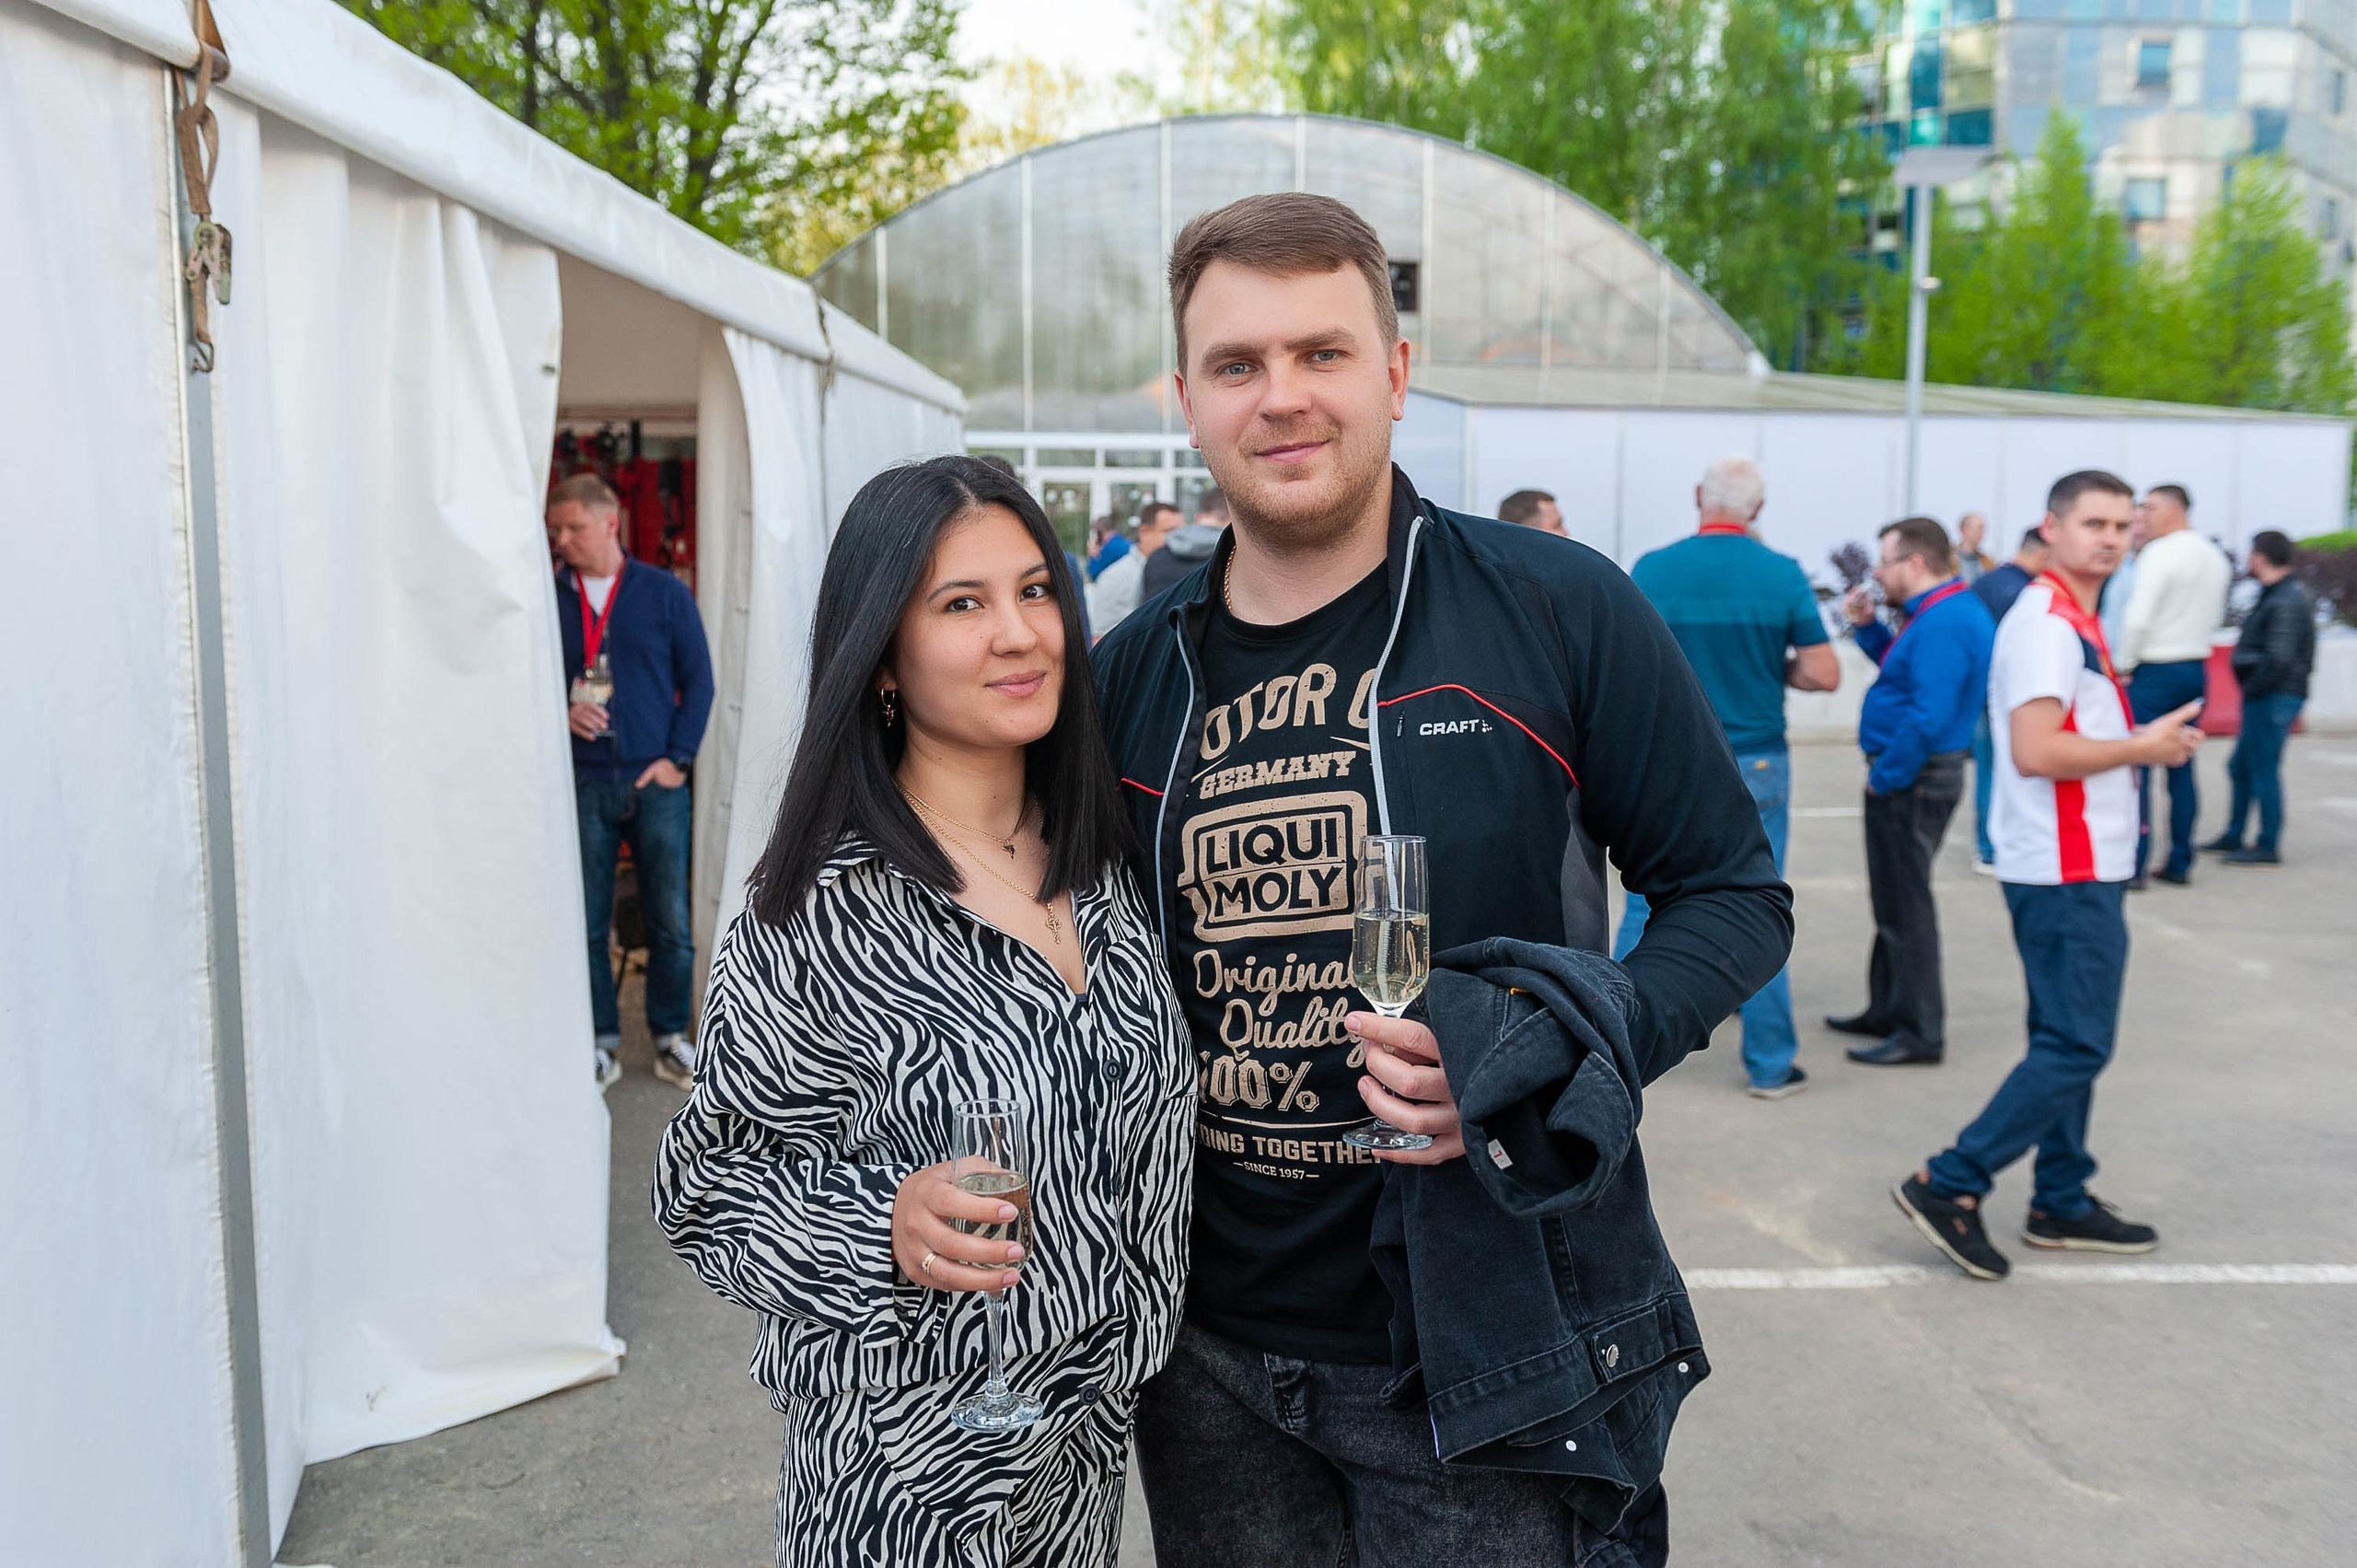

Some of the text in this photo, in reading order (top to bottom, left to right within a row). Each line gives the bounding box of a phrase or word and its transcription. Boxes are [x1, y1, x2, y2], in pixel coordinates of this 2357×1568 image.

[1419, 719, 1480, 736] CRAFT
[1199, 750, 1357, 799] GERMANY
[1205, 817, 1339, 875] LIQUI
[1213, 865, 1342, 917] MOLY
[1251, 1135, 1381, 1164] TOGETHE
